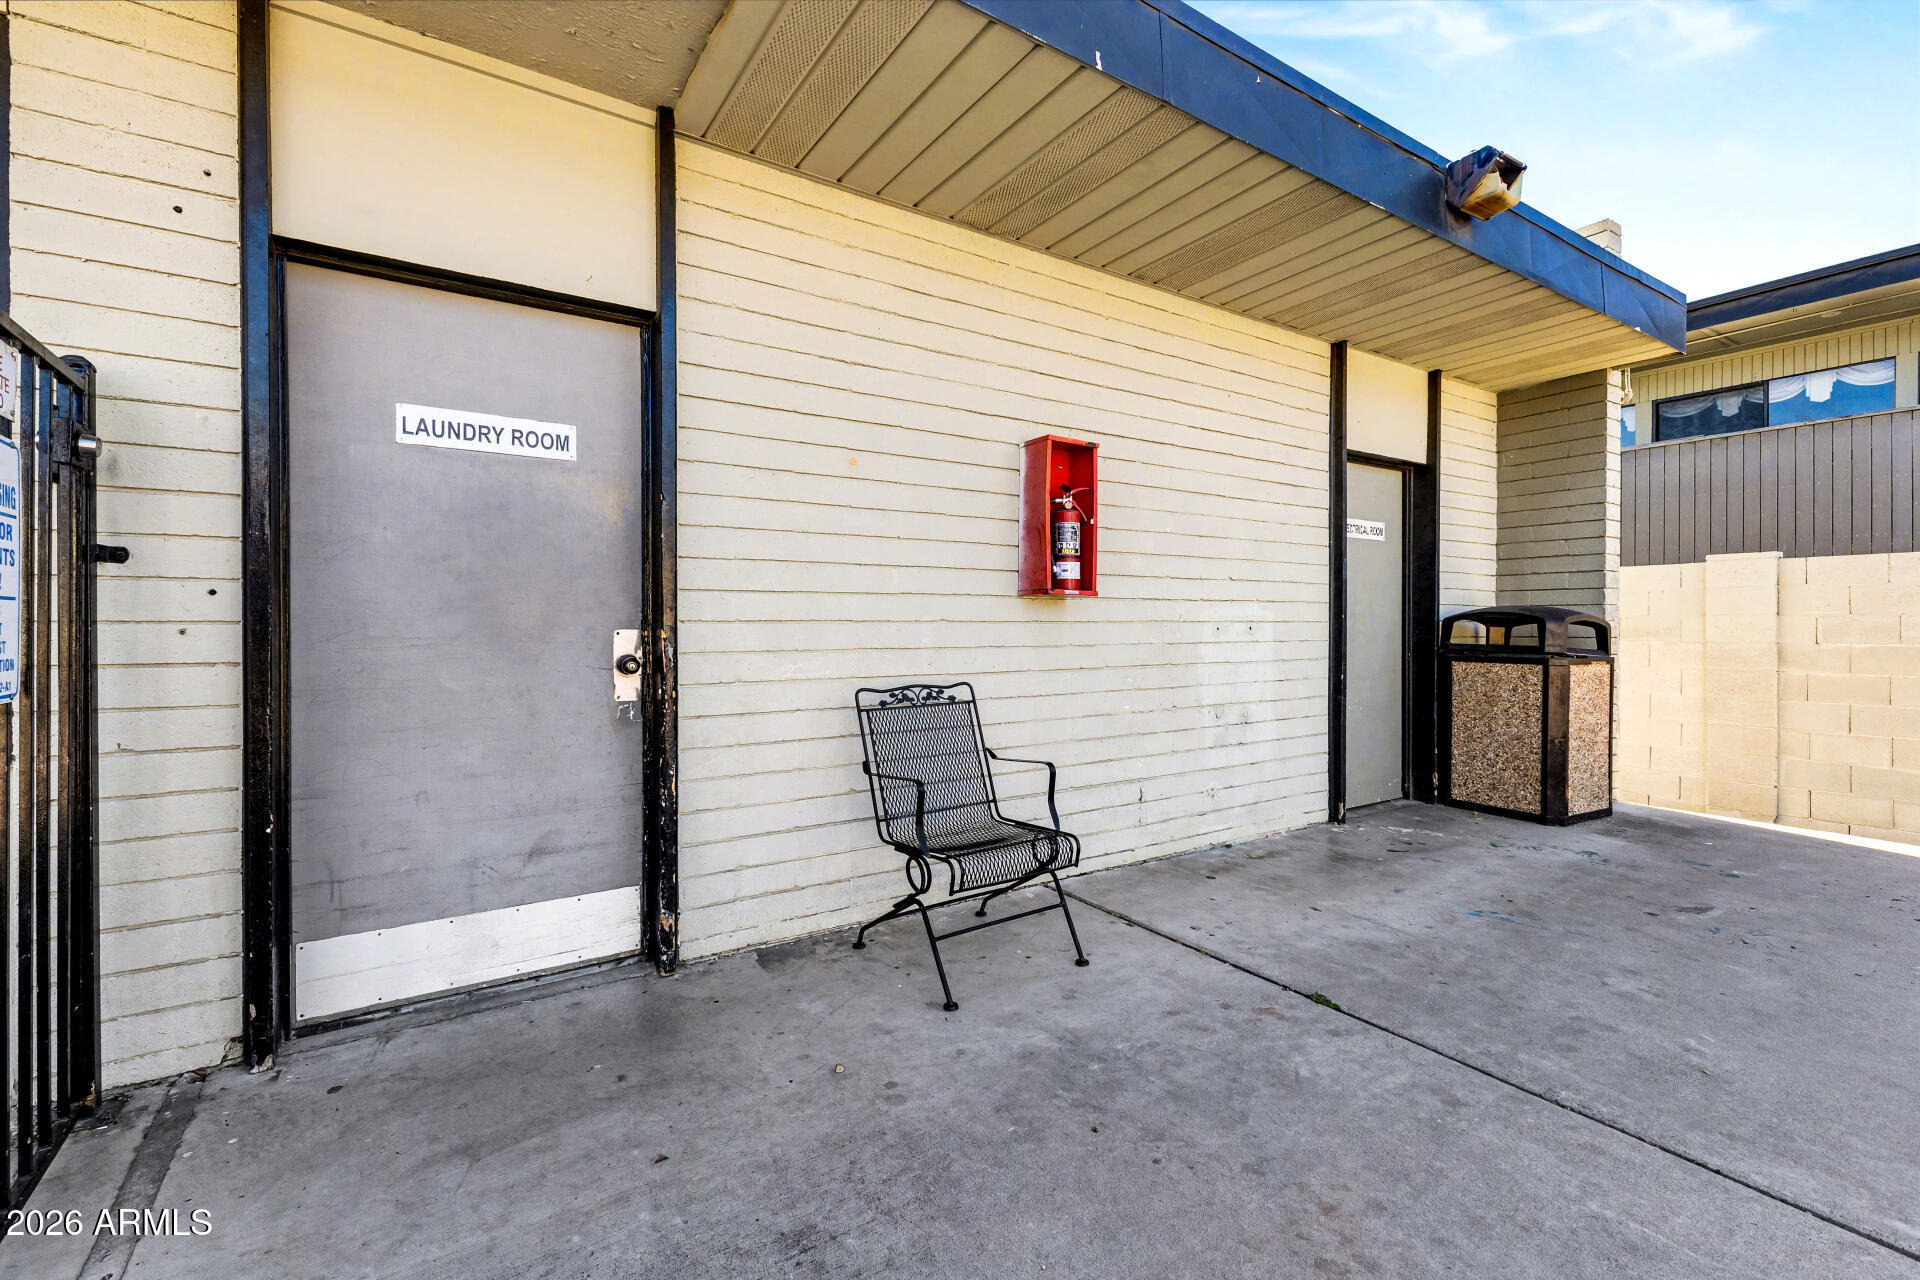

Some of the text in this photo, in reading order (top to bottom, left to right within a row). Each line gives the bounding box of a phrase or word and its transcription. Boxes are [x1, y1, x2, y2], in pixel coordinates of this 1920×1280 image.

[402, 416, 570, 452] LAUNDRY ROOM
[1370, 526, 1383, 537] ROOM
